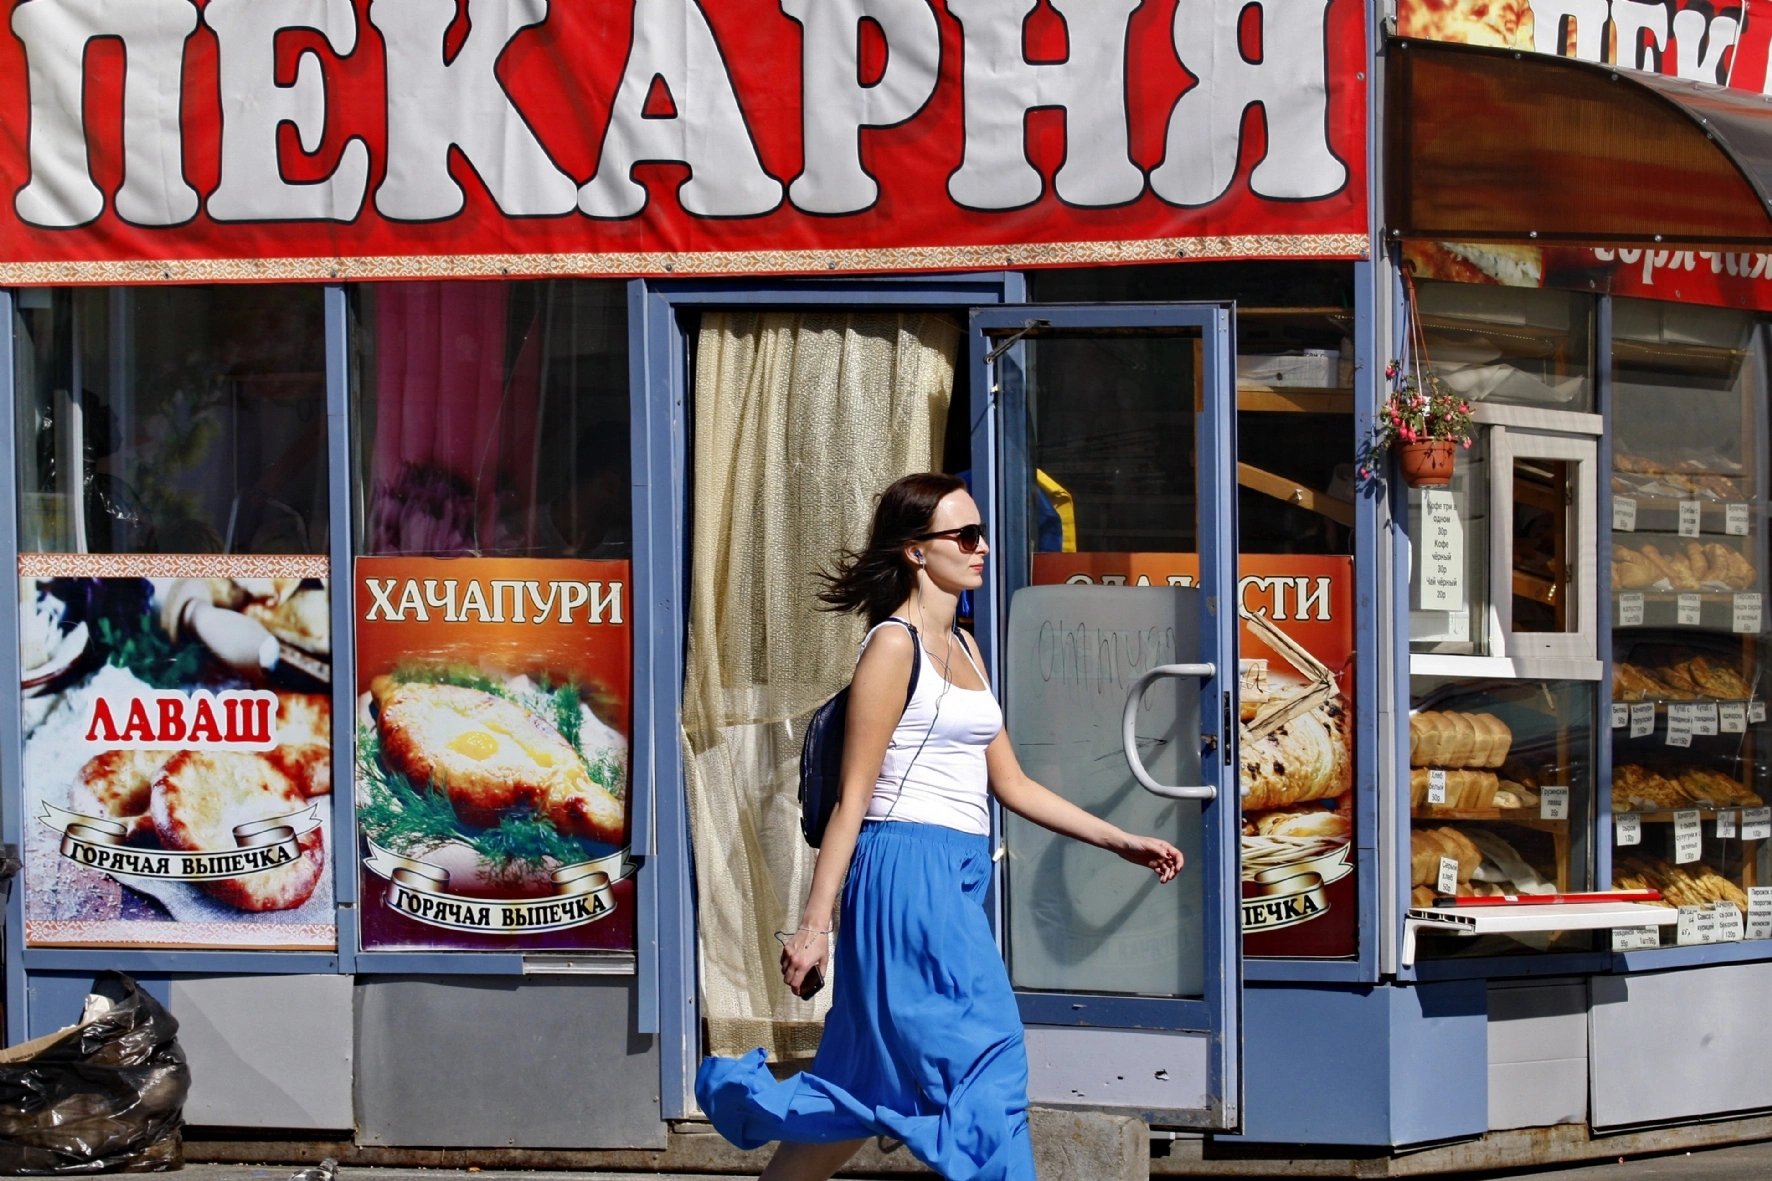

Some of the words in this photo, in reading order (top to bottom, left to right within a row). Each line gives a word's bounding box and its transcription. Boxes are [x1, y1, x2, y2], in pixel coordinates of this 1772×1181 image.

[10, 0, 1350, 228] ПЕКАРНЯ
[1433, 515, 1450, 524] одном
[1437, 526, 1448, 537] 30р
[1434, 539, 1449, 551] Кофе
[1432, 552, 1451, 562] чёрный
[1437, 564, 1447, 576] 30р
[1426, 577, 1436, 586] Чай
[1436, 577, 1457, 588] чёрный
[365, 578, 624, 624] ХАЧАПУРИ
[85, 697, 272, 743] ЛАВАШ
[70, 842, 170, 874] ГОРЯЧАЯ
[181, 845, 292, 875] ВЫПЕЧКА
[395, 888, 491, 926] ГОРЯЧАЯ
[501, 892, 608, 927] ВЫПЕЧКА
